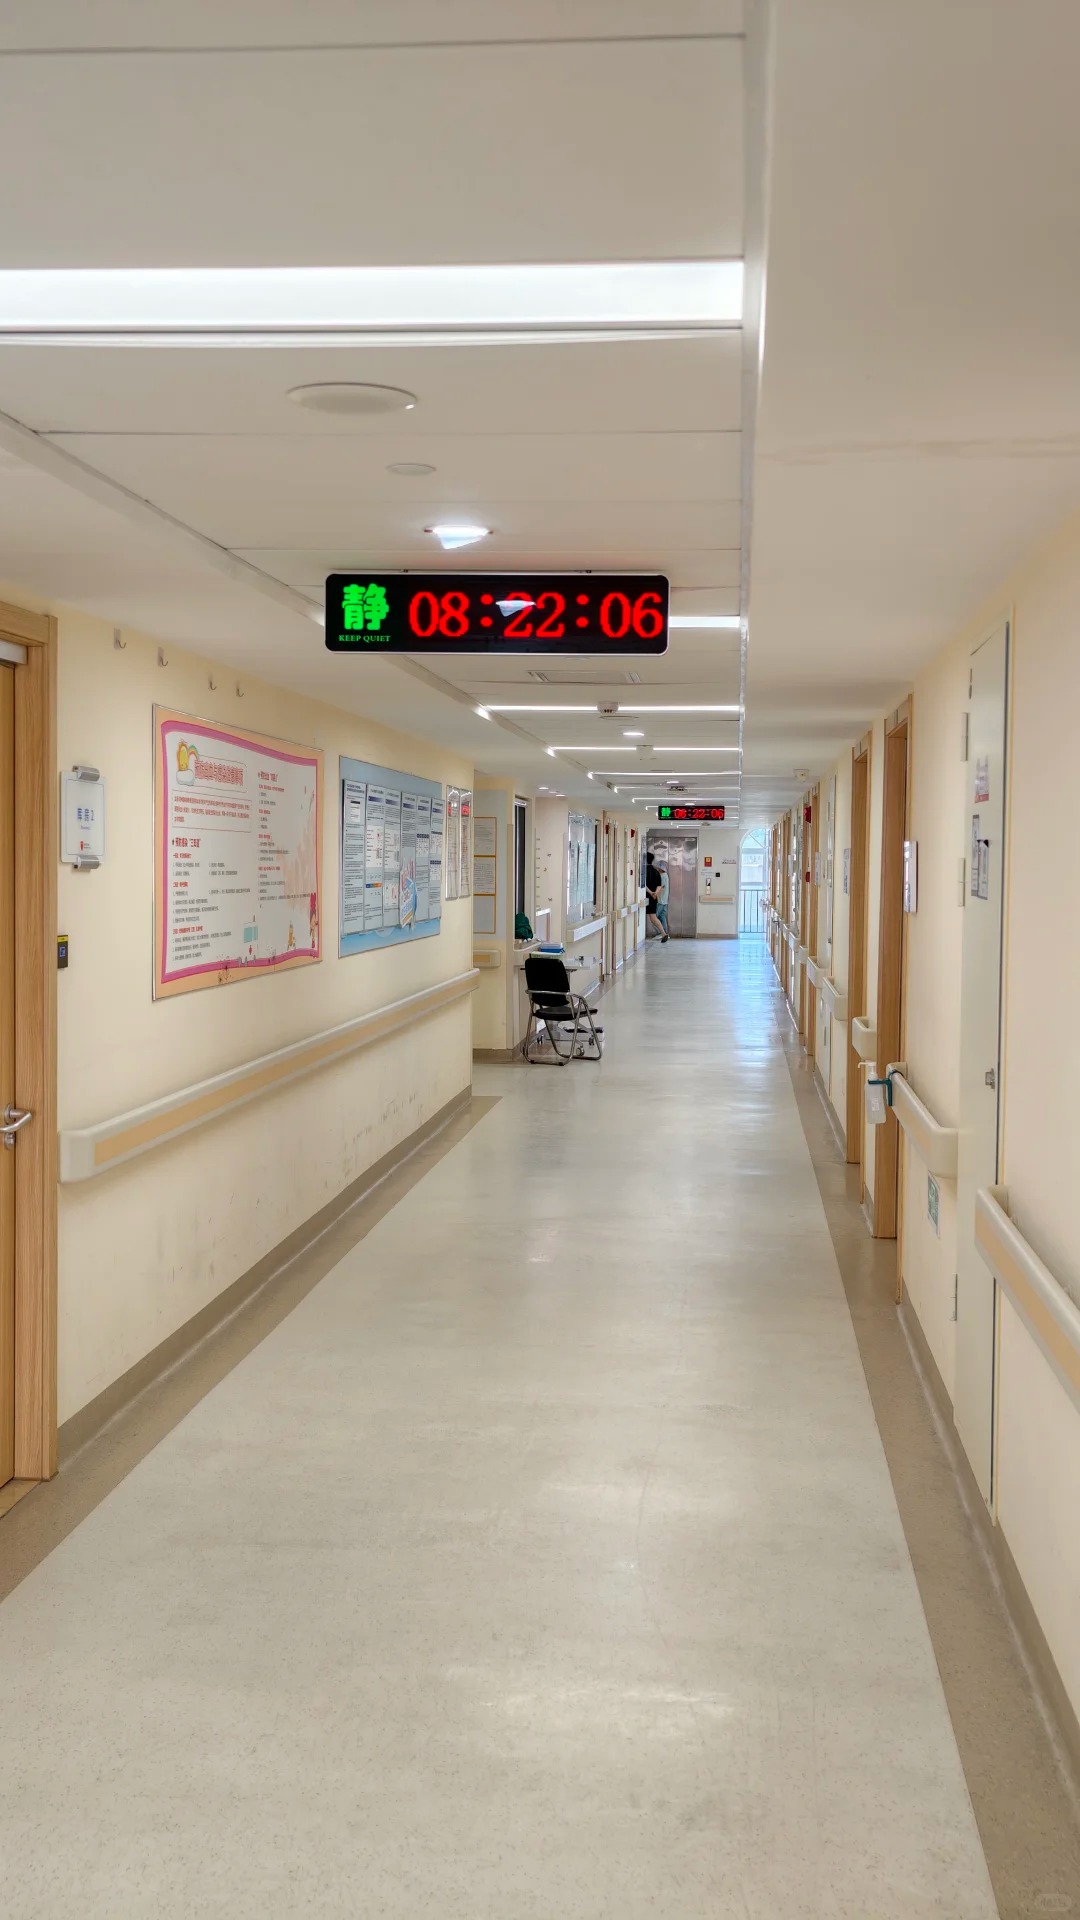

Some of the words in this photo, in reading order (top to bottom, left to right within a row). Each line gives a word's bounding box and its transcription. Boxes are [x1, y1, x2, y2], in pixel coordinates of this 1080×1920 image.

[342, 583, 389, 630] 静
[409, 592, 663, 638] 08:22:06
[363, 635, 391, 643] QUIET
